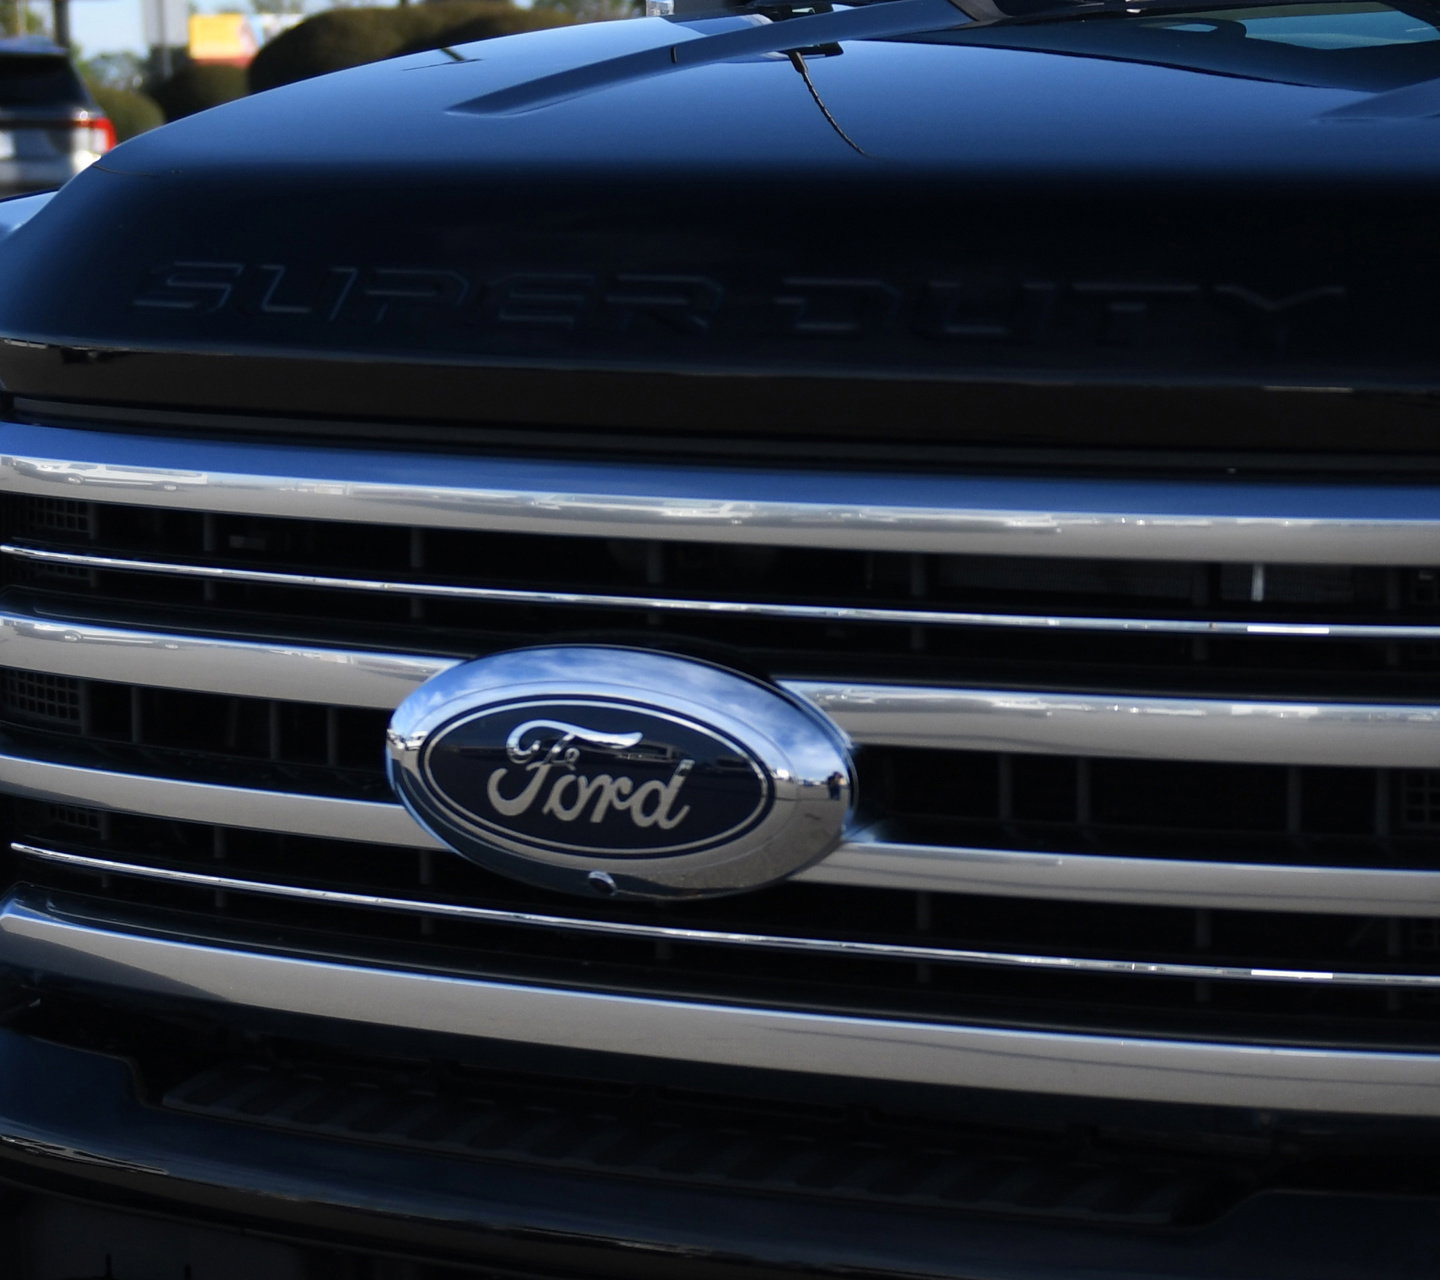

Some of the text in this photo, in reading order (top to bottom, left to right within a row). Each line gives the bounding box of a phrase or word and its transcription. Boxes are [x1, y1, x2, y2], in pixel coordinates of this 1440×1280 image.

[132, 260, 1347, 351] SUPER DUTY
[488, 719, 695, 830] Ford
